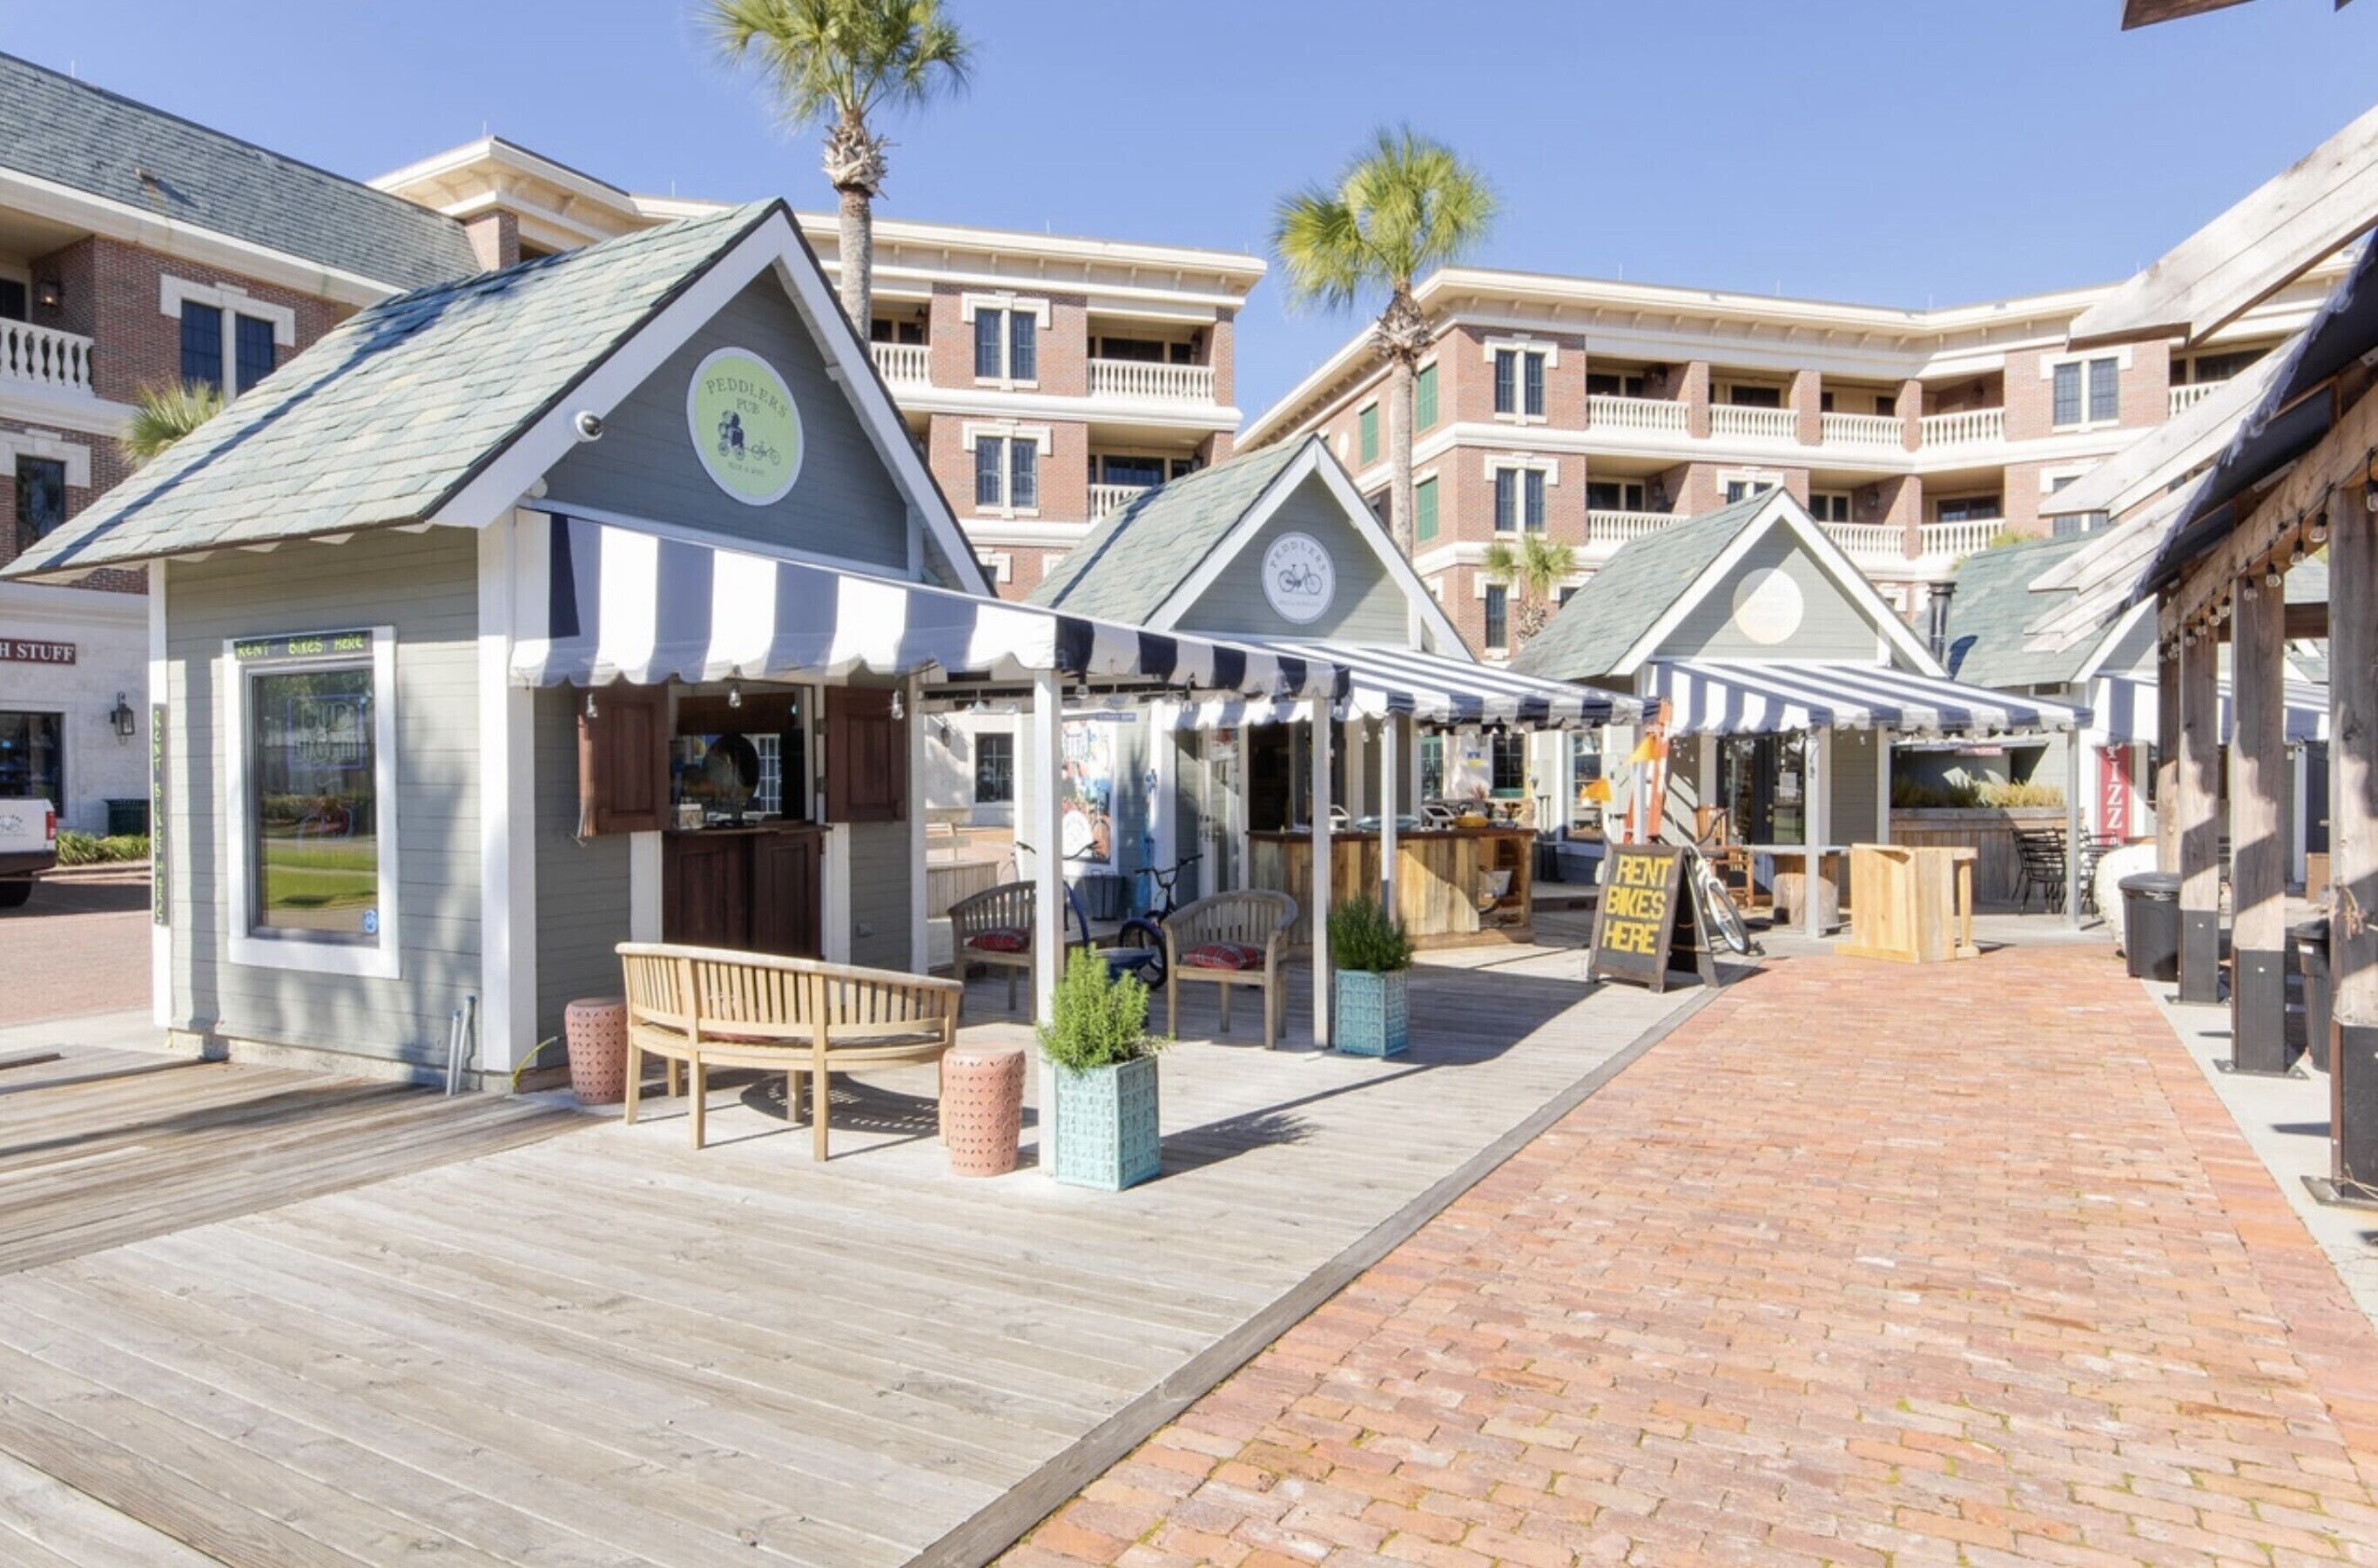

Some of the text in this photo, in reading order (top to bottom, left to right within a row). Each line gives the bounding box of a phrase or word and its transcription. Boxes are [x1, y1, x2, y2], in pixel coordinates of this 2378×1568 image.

[706, 376, 788, 418] PEDDLERS
[736, 397, 761, 415] PUB
[17, 643, 75, 662] STUFF
[1615, 854, 1674, 887] RENT
[1604, 885, 1667, 921] BIKES
[1601, 919, 1661, 955] HERE
